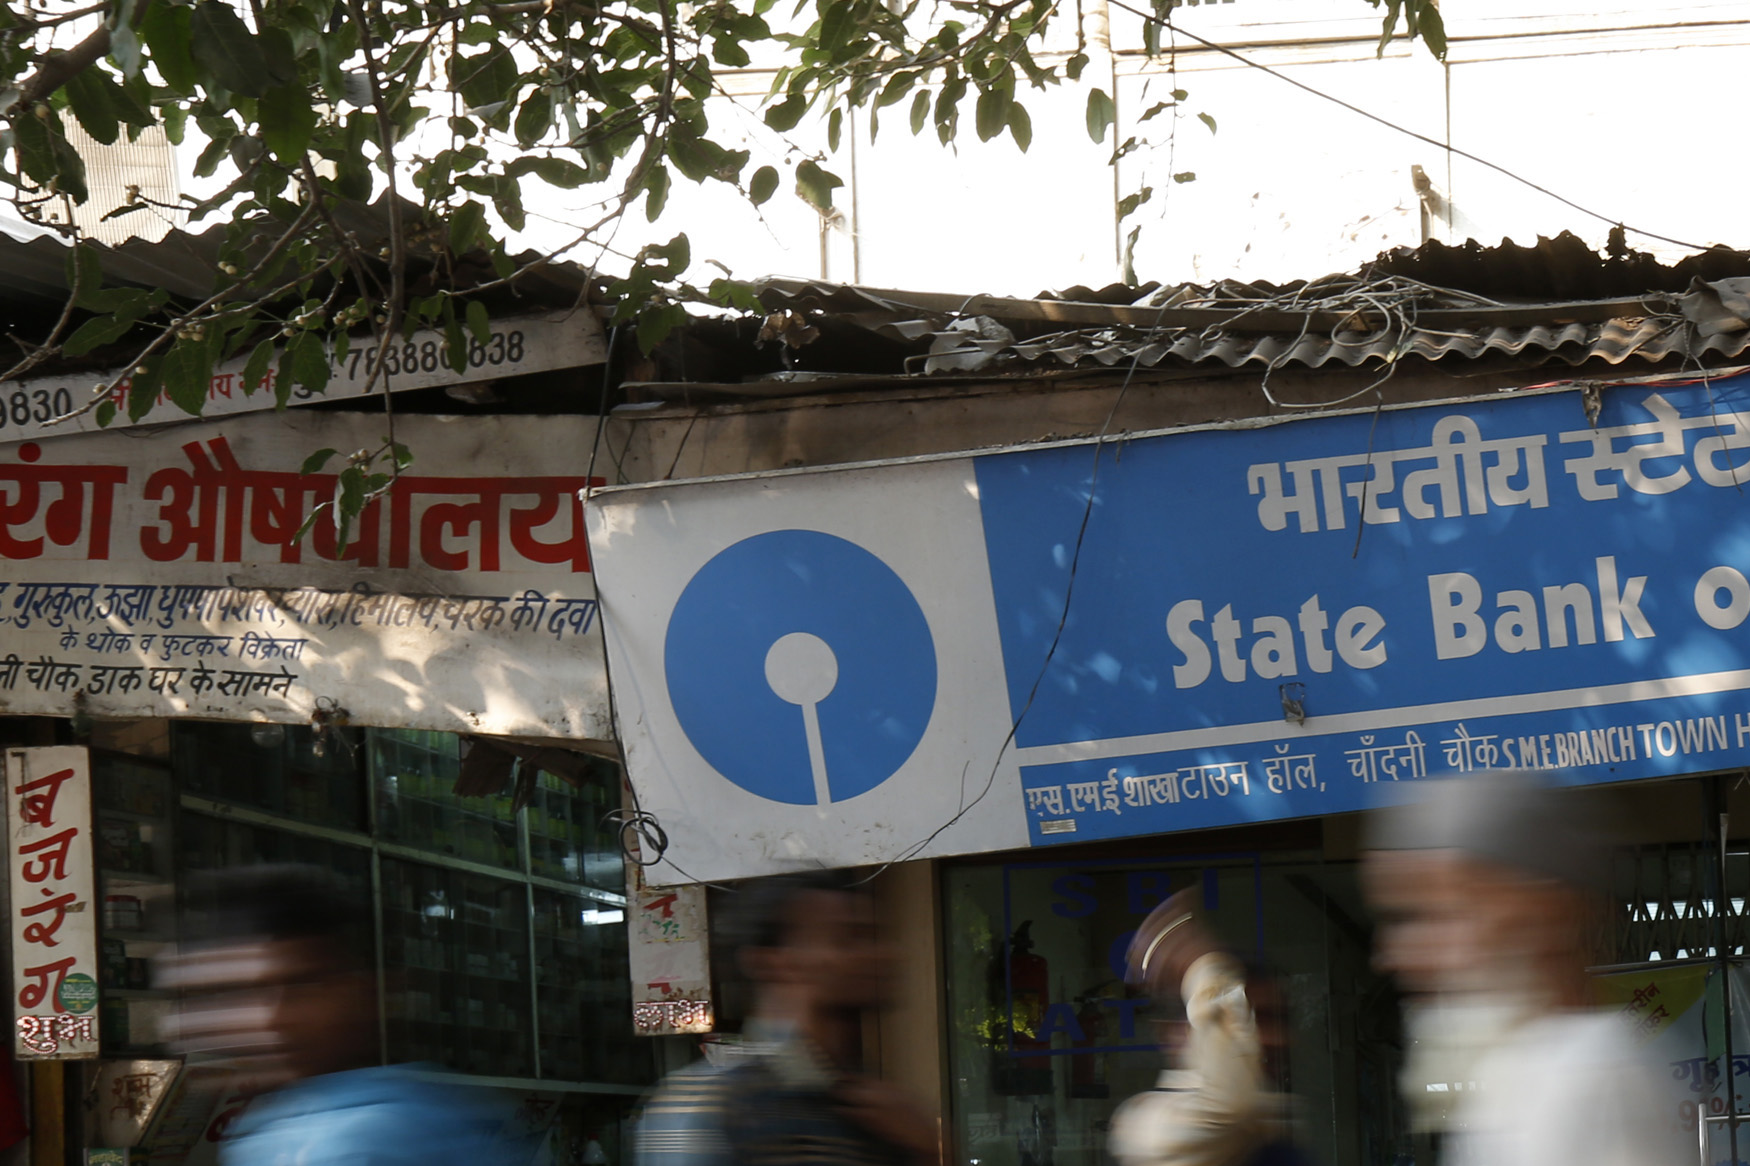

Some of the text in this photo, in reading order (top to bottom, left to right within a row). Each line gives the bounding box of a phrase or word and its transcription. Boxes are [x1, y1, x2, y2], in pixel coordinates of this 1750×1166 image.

[1246, 415, 1550, 534] भारतीय
[59, 624, 80, 651] के
[86, 626, 136, 653] थोक
[139, 634, 157, 654] व
[160, 635, 235, 661] फुटकर
[1165, 592, 1388, 690] State
[1427, 554, 1656, 661] Bank
[86, 665, 145, 696] डाक
[148, 667, 188, 695] घर
[187, 661, 217, 695] के
[217, 665, 299, 698] सामने
[1343, 729, 1427, 784] चाँदनी
[1637, 714, 1730, 759] TOWN
